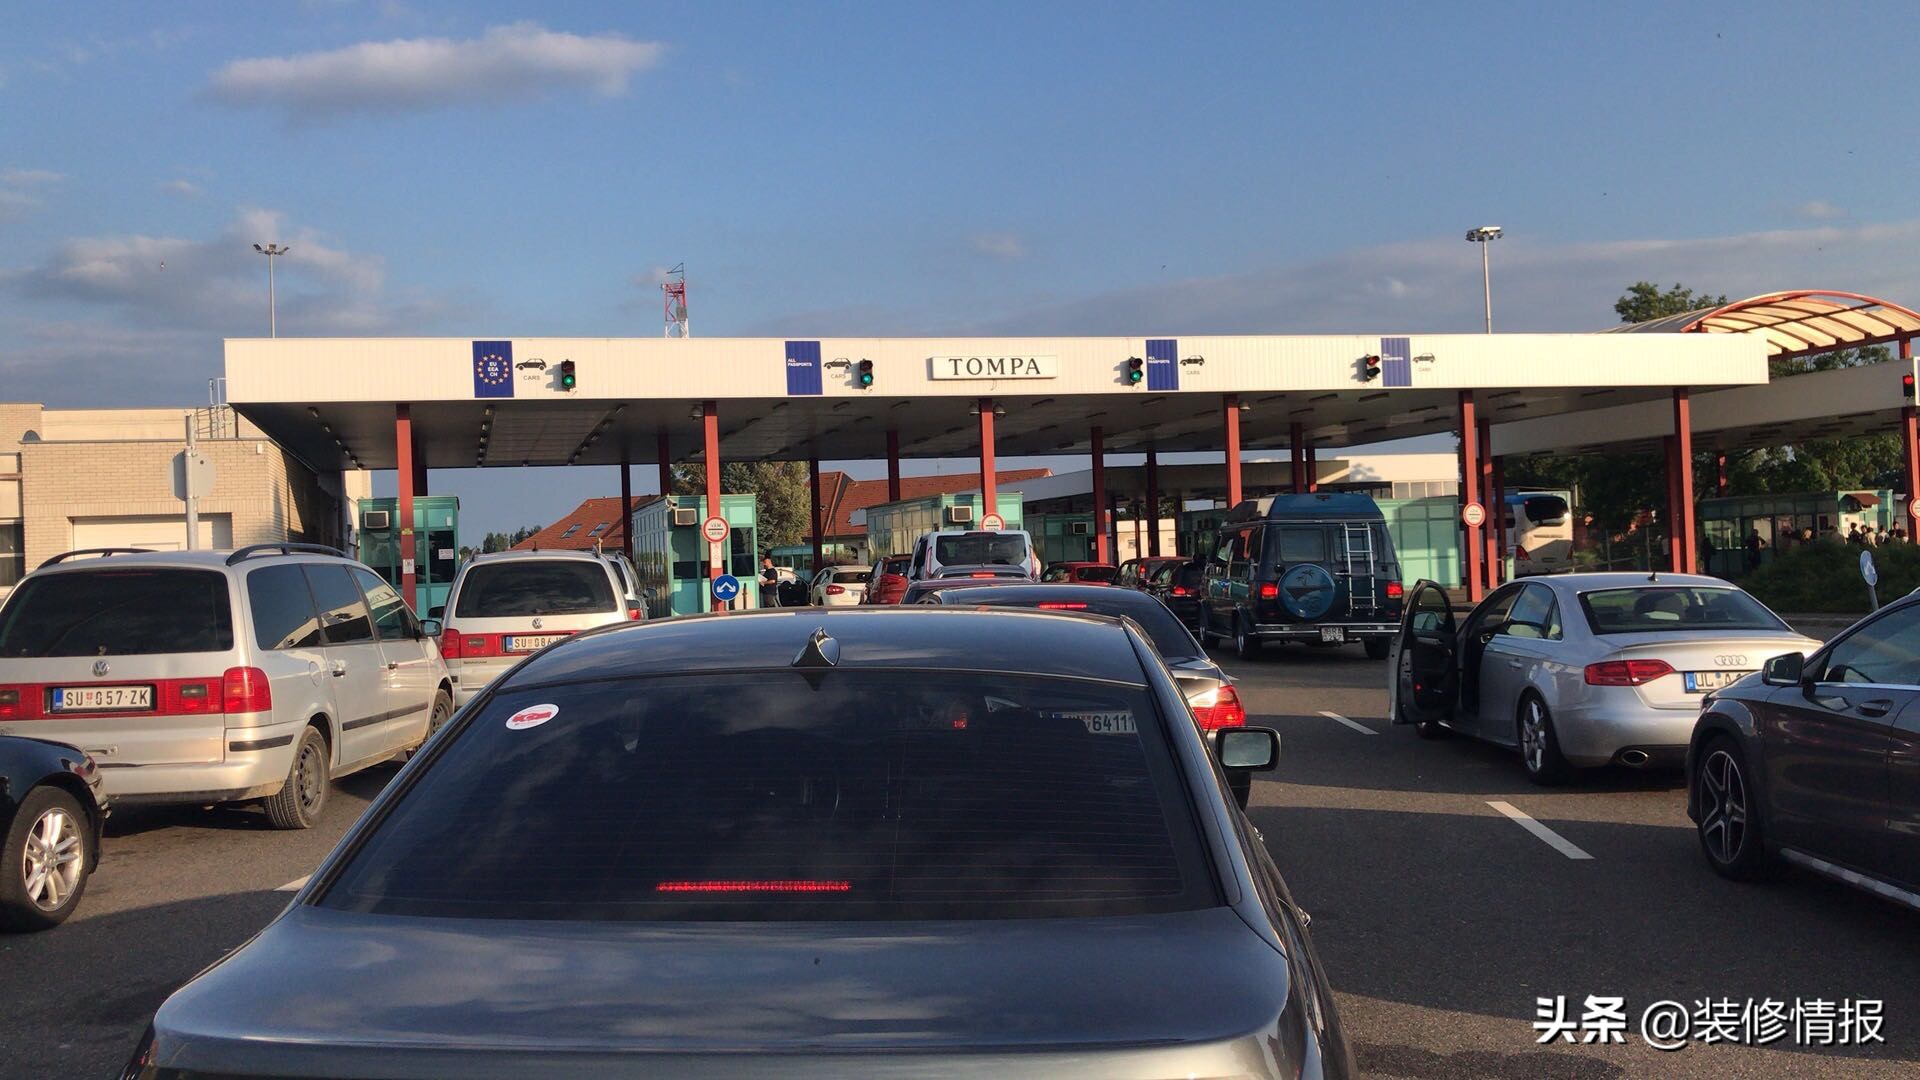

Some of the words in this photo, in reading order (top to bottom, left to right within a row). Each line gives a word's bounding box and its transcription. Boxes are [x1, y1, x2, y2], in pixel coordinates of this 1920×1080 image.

[948, 357, 1041, 376] TOMPA
[515, 639, 527, 648] SU
[1695, 673, 1714, 688] UL
[65, 691, 84, 707] SU
